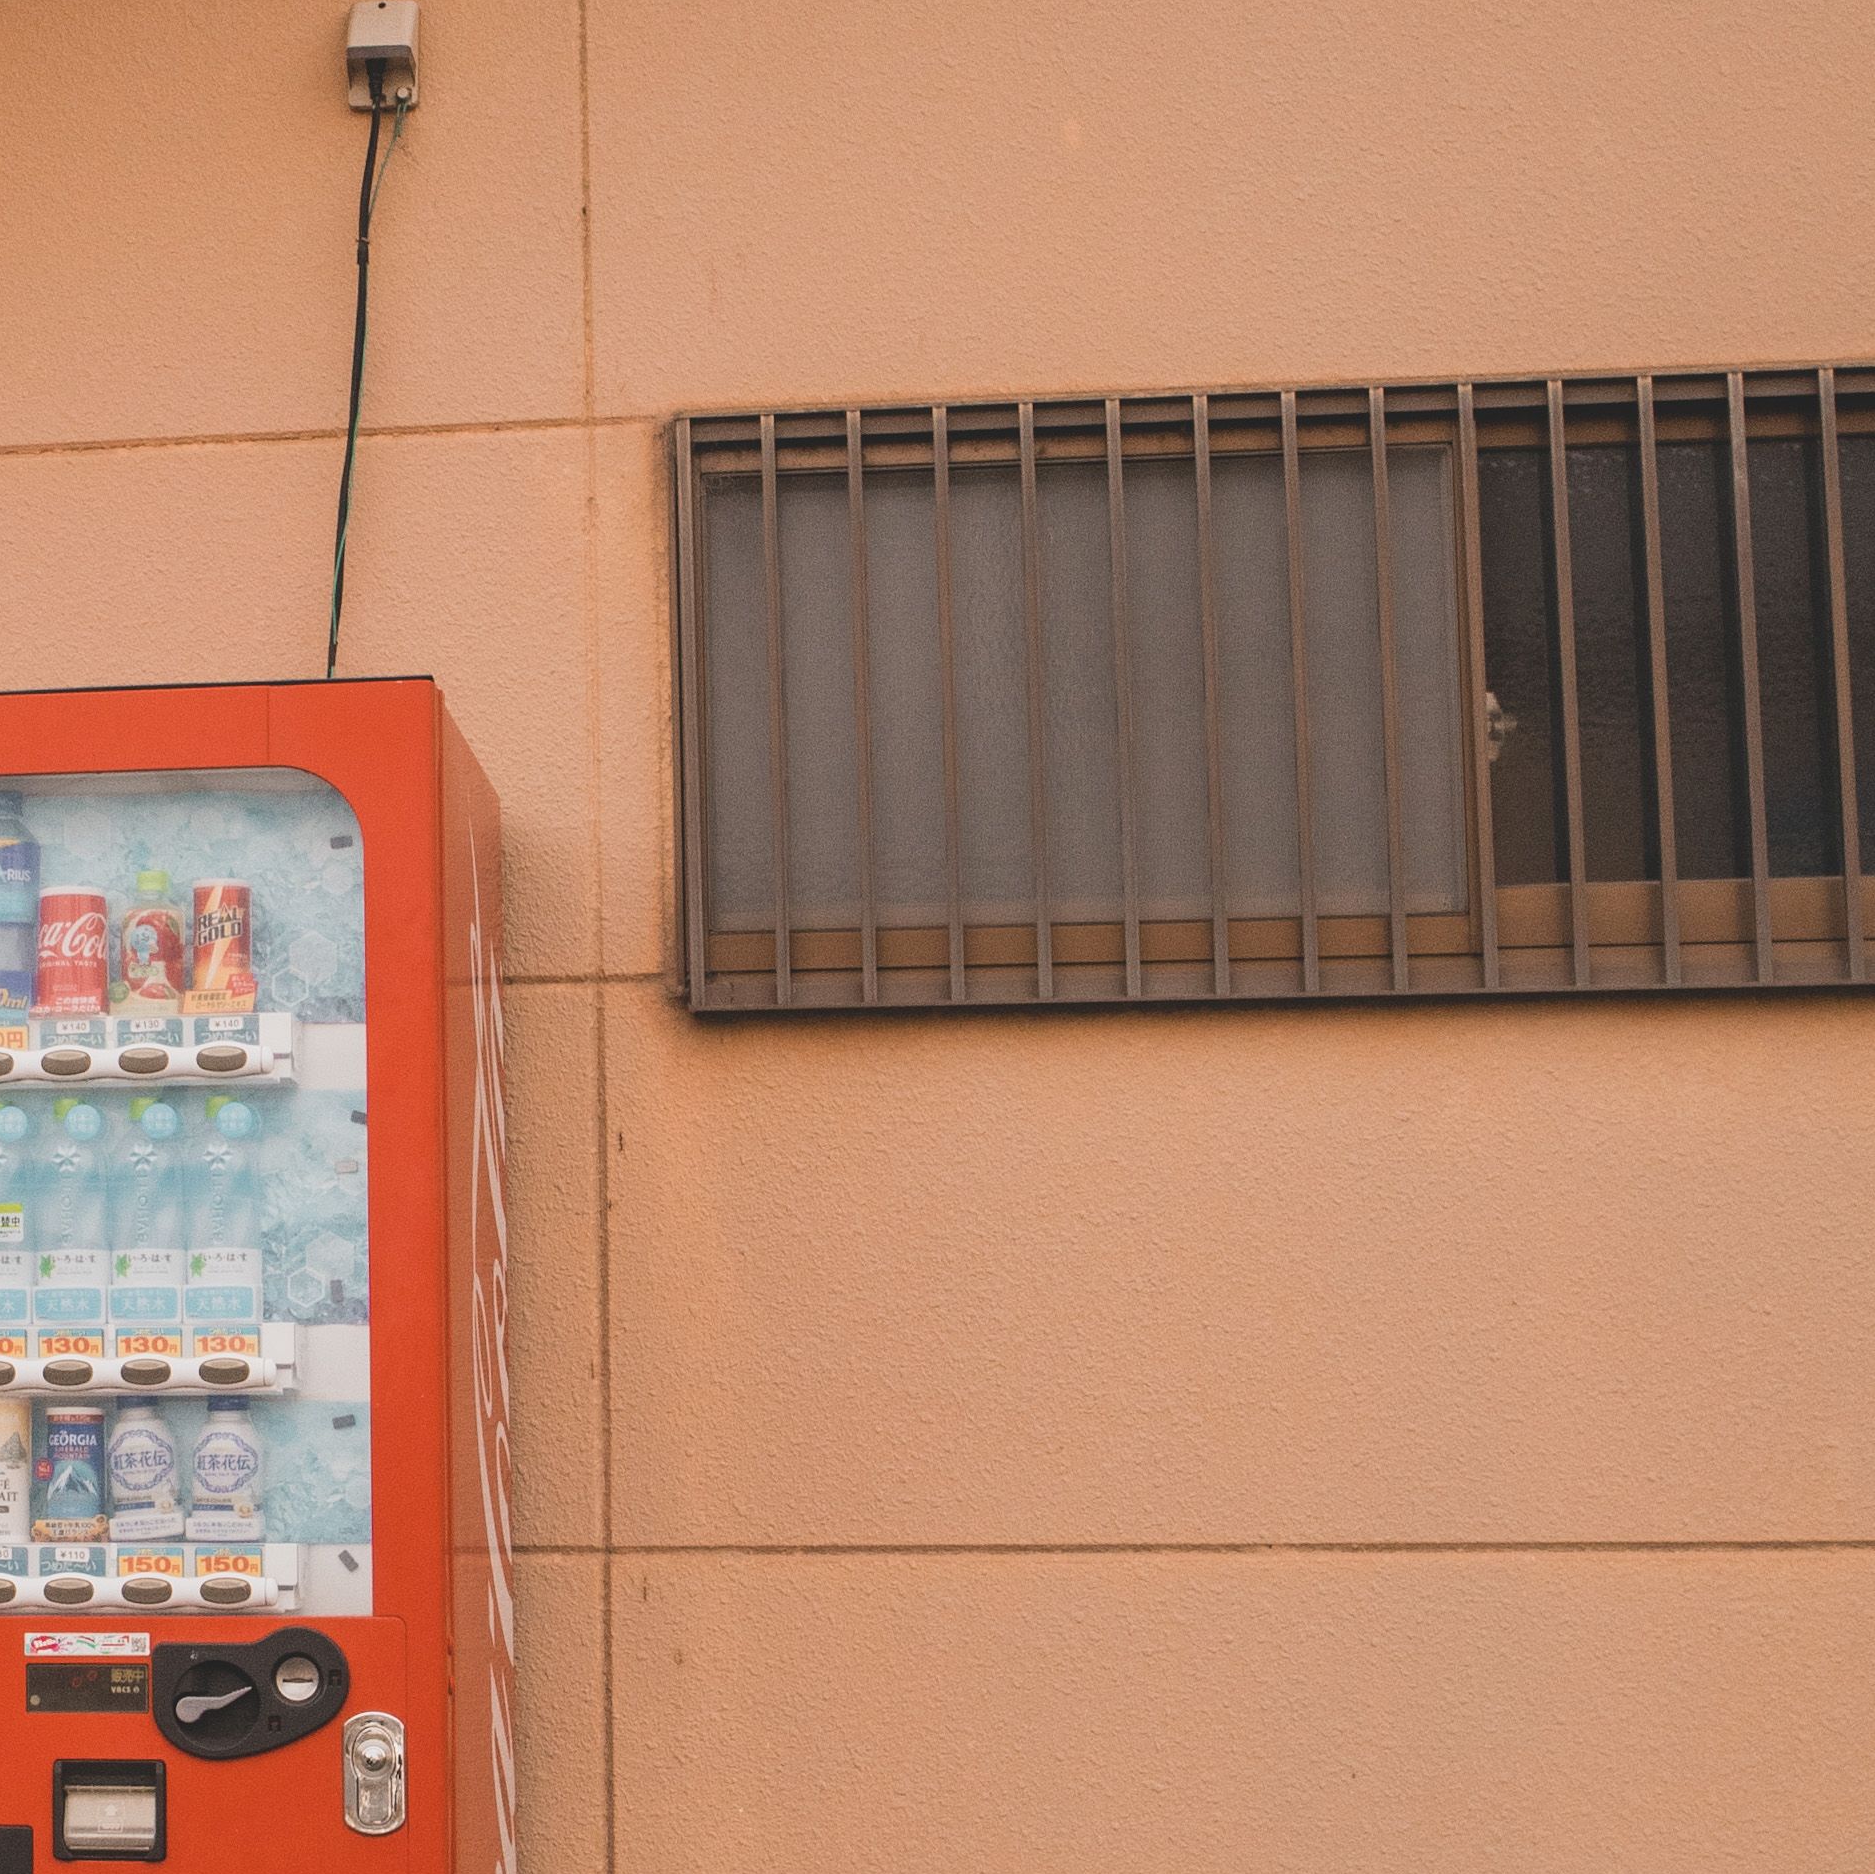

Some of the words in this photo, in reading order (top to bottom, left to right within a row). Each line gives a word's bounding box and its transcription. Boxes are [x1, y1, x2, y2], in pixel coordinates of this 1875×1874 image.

[197, 903, 241, 930] REAL
[198, 922, 242, 947] GOLD
[61, 1022, 87, 1031] ¥140
[135, 1020, 159, 1029] ¥130
[215, 1019, 240, 1028] ¥140
[42, 1336, 99, 1354] 130円
[119, 1336, 177, 1354] 130円
[197, 1335, 255, 1353] 130円
[112, 1450, 168, 1470] 紅茶花伝
[197, 1454, 252, 1471] 紅茶花伝
[60, 1551, 86, 1559] ¥110
[122, 1556, 181, 1573] 150円
[200, 1556, 259, 1573] 150円
